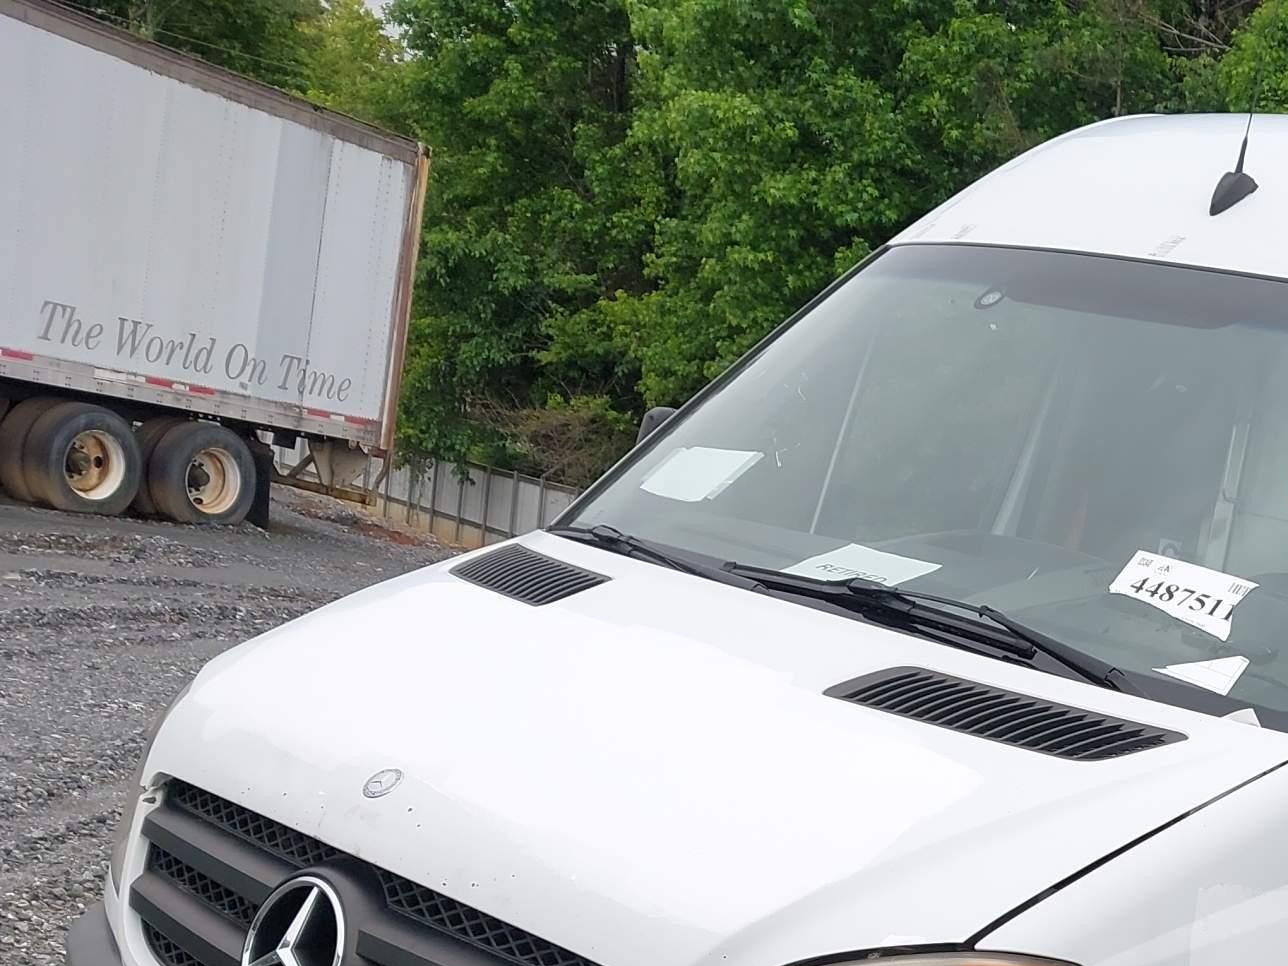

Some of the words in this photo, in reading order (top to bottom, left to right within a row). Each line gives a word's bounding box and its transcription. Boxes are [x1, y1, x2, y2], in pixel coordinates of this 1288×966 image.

[38, 299, 104, 350] The
[115, 317, 217, 376] World
[223, 342, 269, 386] On
[277, 353, 353, 403] Time
